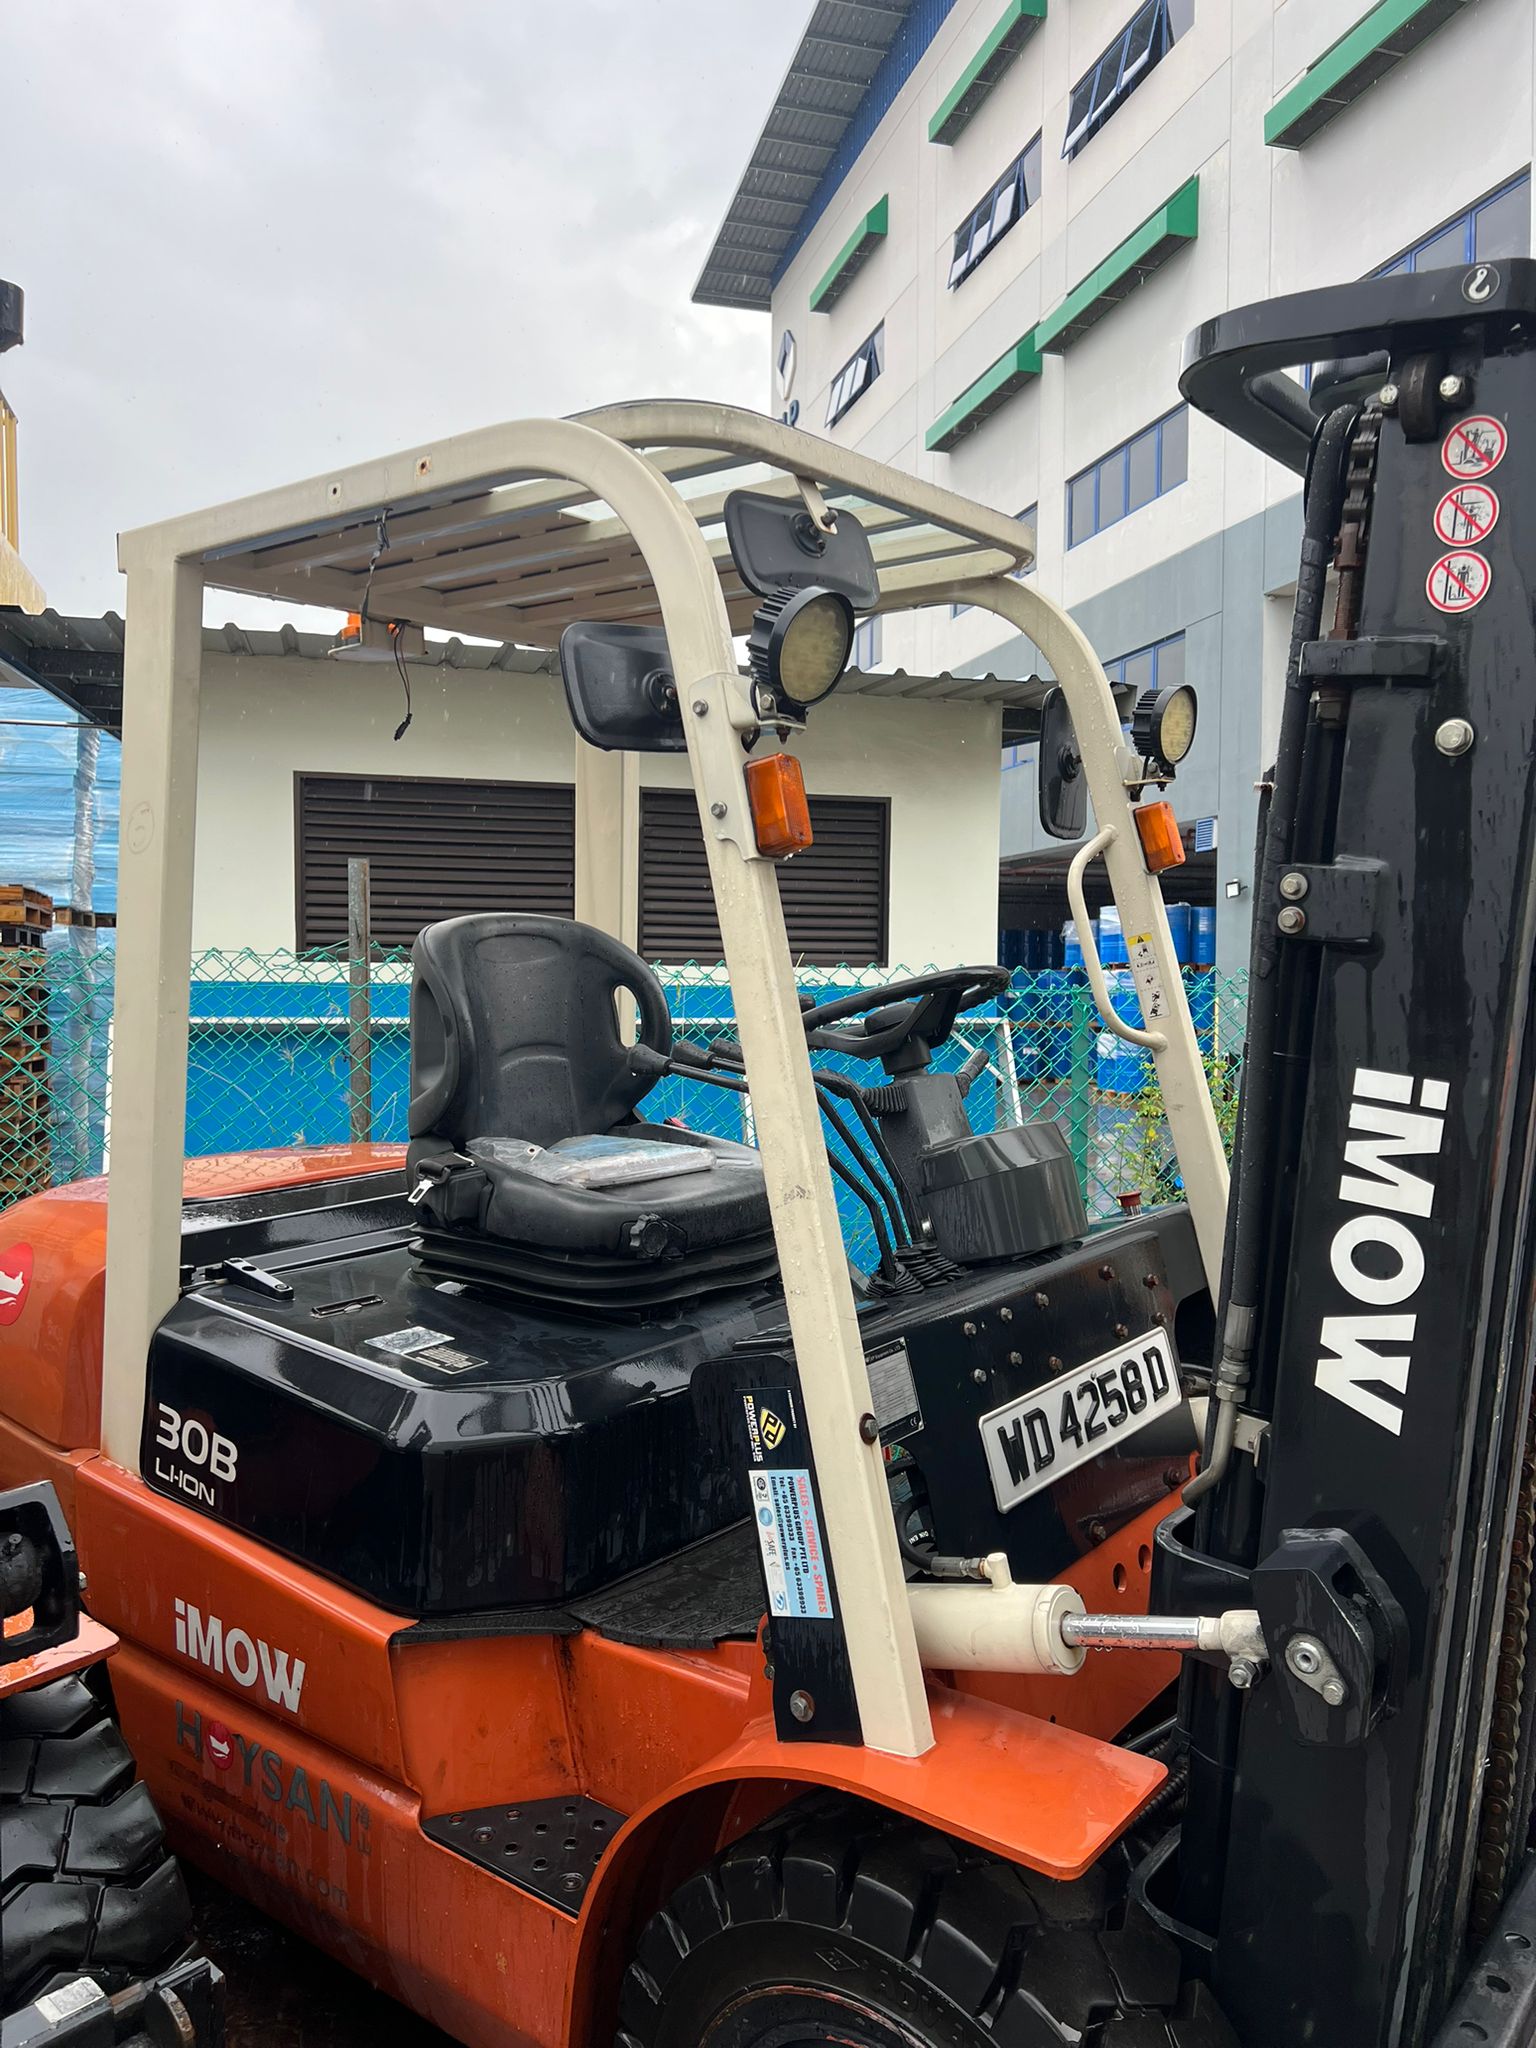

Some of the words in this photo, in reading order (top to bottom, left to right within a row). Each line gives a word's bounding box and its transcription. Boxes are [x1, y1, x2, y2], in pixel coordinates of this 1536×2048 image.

[1314, 1068, 1450, 1436] iMOW
[156, 1402, 238, 1483] 30B
[746, 1395, 763, 1462] POWERPLUS
[997, 1407, 1055, 1487] WD
[1060, 1359, 1147, 1449] 4258
[1142, 1346, 1170, 1402] D
[787, 1476, 800, 1520] POWERPLUS
[795, 1521, 805, 1546] GROUP
[797, 1476, 809, 1507] SALES
[804, 1519, 819, 1561] SERVICE
[813, 1574, 827, 1613] SPARES
[799, 1547, 807, 1560] PTE
[175, 1598, 306, 1714] iMOW
